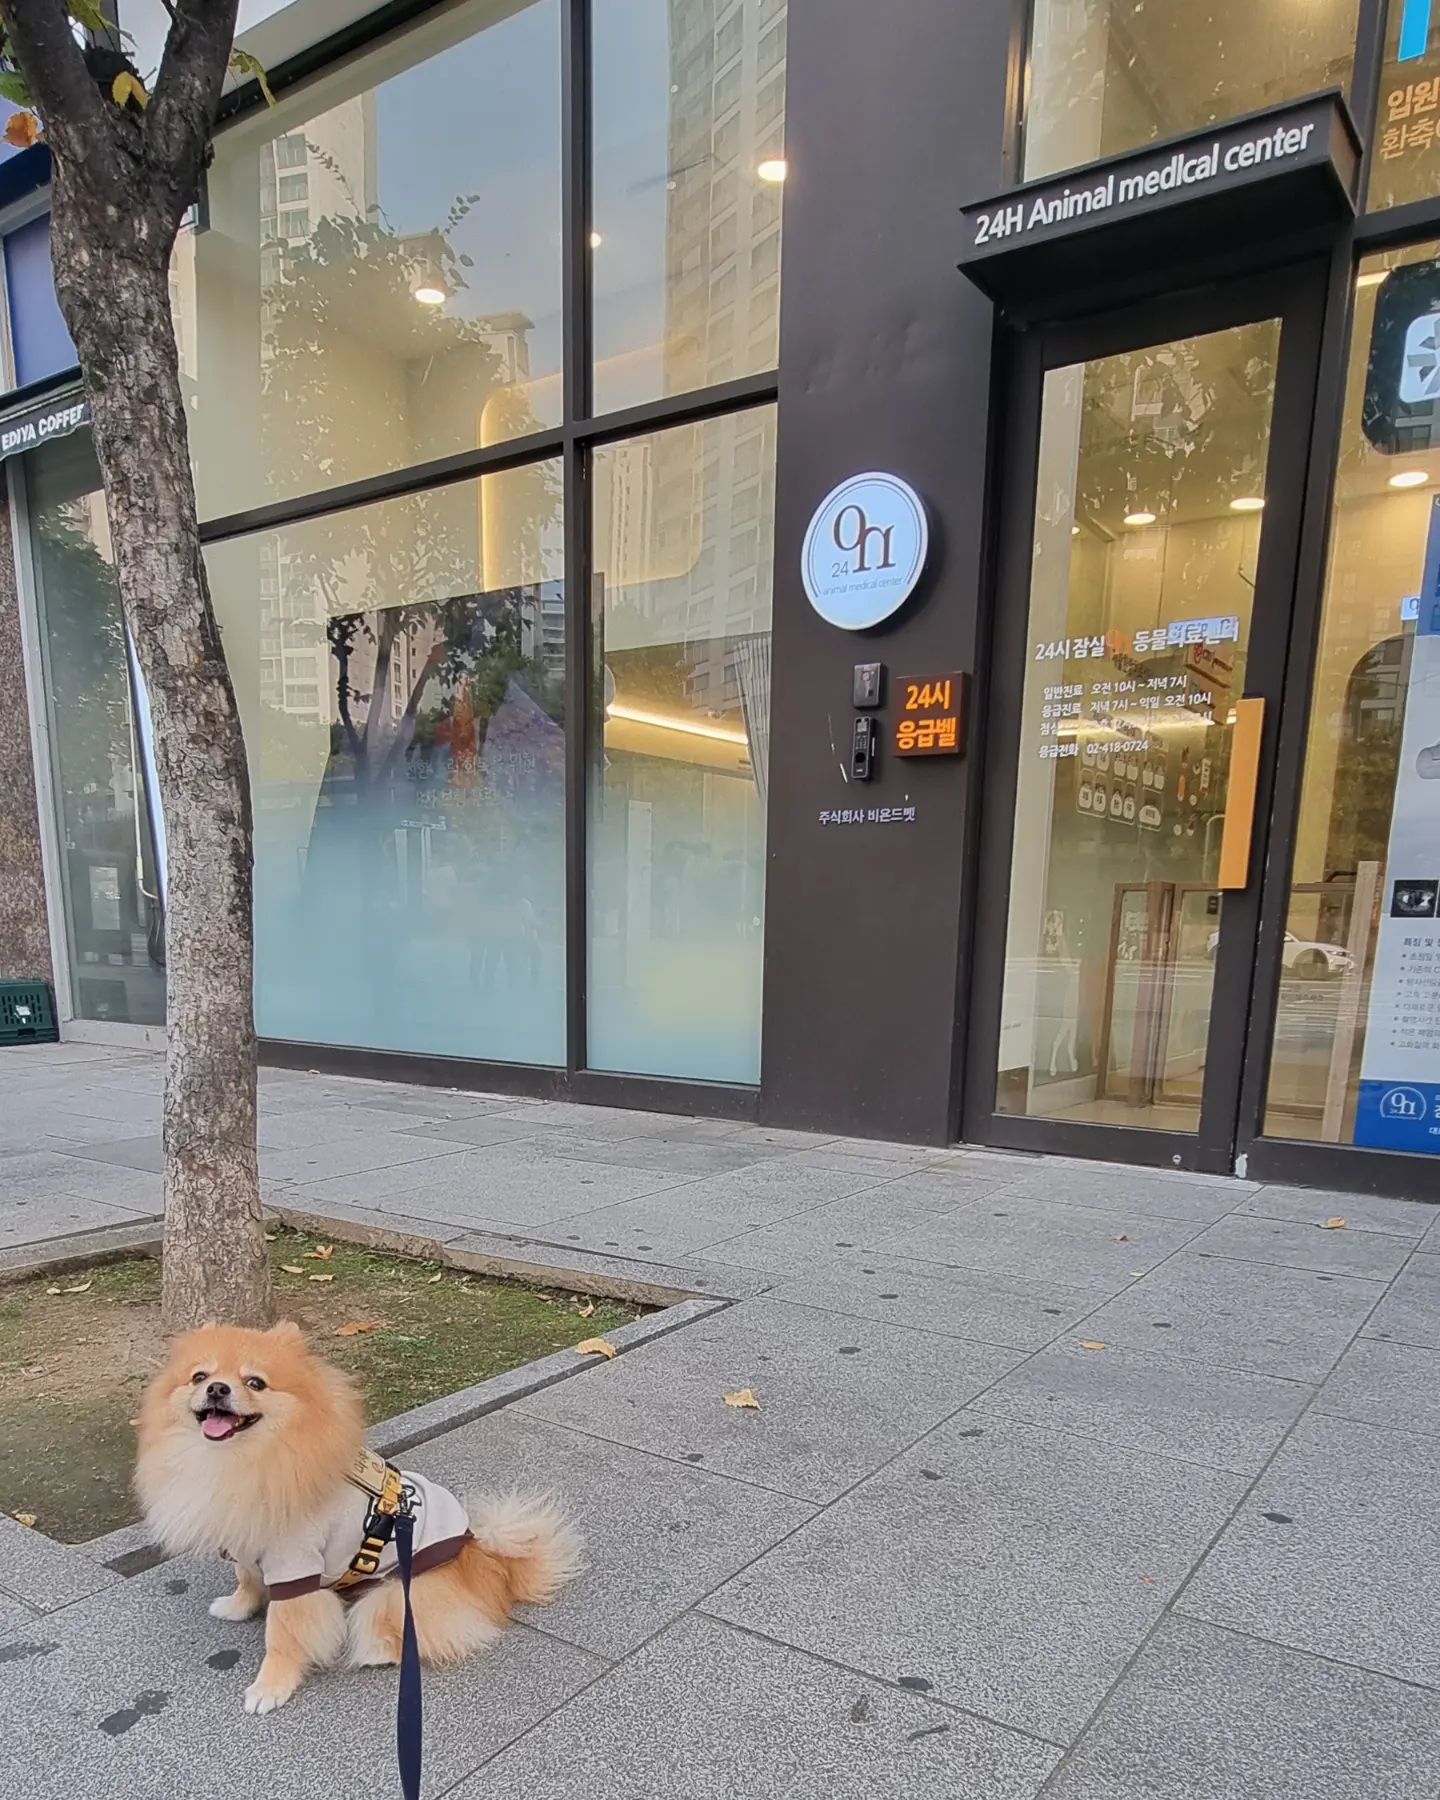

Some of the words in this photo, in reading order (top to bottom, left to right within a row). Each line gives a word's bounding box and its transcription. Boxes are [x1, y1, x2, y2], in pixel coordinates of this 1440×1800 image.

[1380, 118, 1440, 160] 환축
[974, 205, 1024, 245] 24H
[1027, 175, 1114, 230] Animal
[1224, 123, 1315, 171] center
[2, 423, 36, 452] EDIYA
[831, 560, 849, 578] 24
[823, 583, 848, 596] animal
[848, 578, 878, 592] medical
[878, 576, 904, 588] center
[1035, 639, 1070, 661] 24시
[1072, 634, 1105, 659] 잠실
[905, 680, 951, 710] 24시
[1043, 684, 1083, 700] 일반진료
[1090, 682, 1111, 695] 오전
[1114, 680, 1136, 693] 10시
[1146, 677, 1168, 691] 저녁
[1169, 674, 1187, 688] 7시
[1041, 702, 1083, 718] 응급진료
[1089, 700, 1110, 713] 저녁
[1111, 698, 1129, 712] 7시
[1139, 696, 1160, 710] 익일
[1164, 694, 1186, 707] 오전
[1188, 691, 1212, 705] 10시
[896, 717, 957, 750] 응급벨
[1038, 743, 1080, 759] 응급전화
[1086, 740, 1149, 755] 02-418-0724
[819, 808, 865, 825] 주식회사
